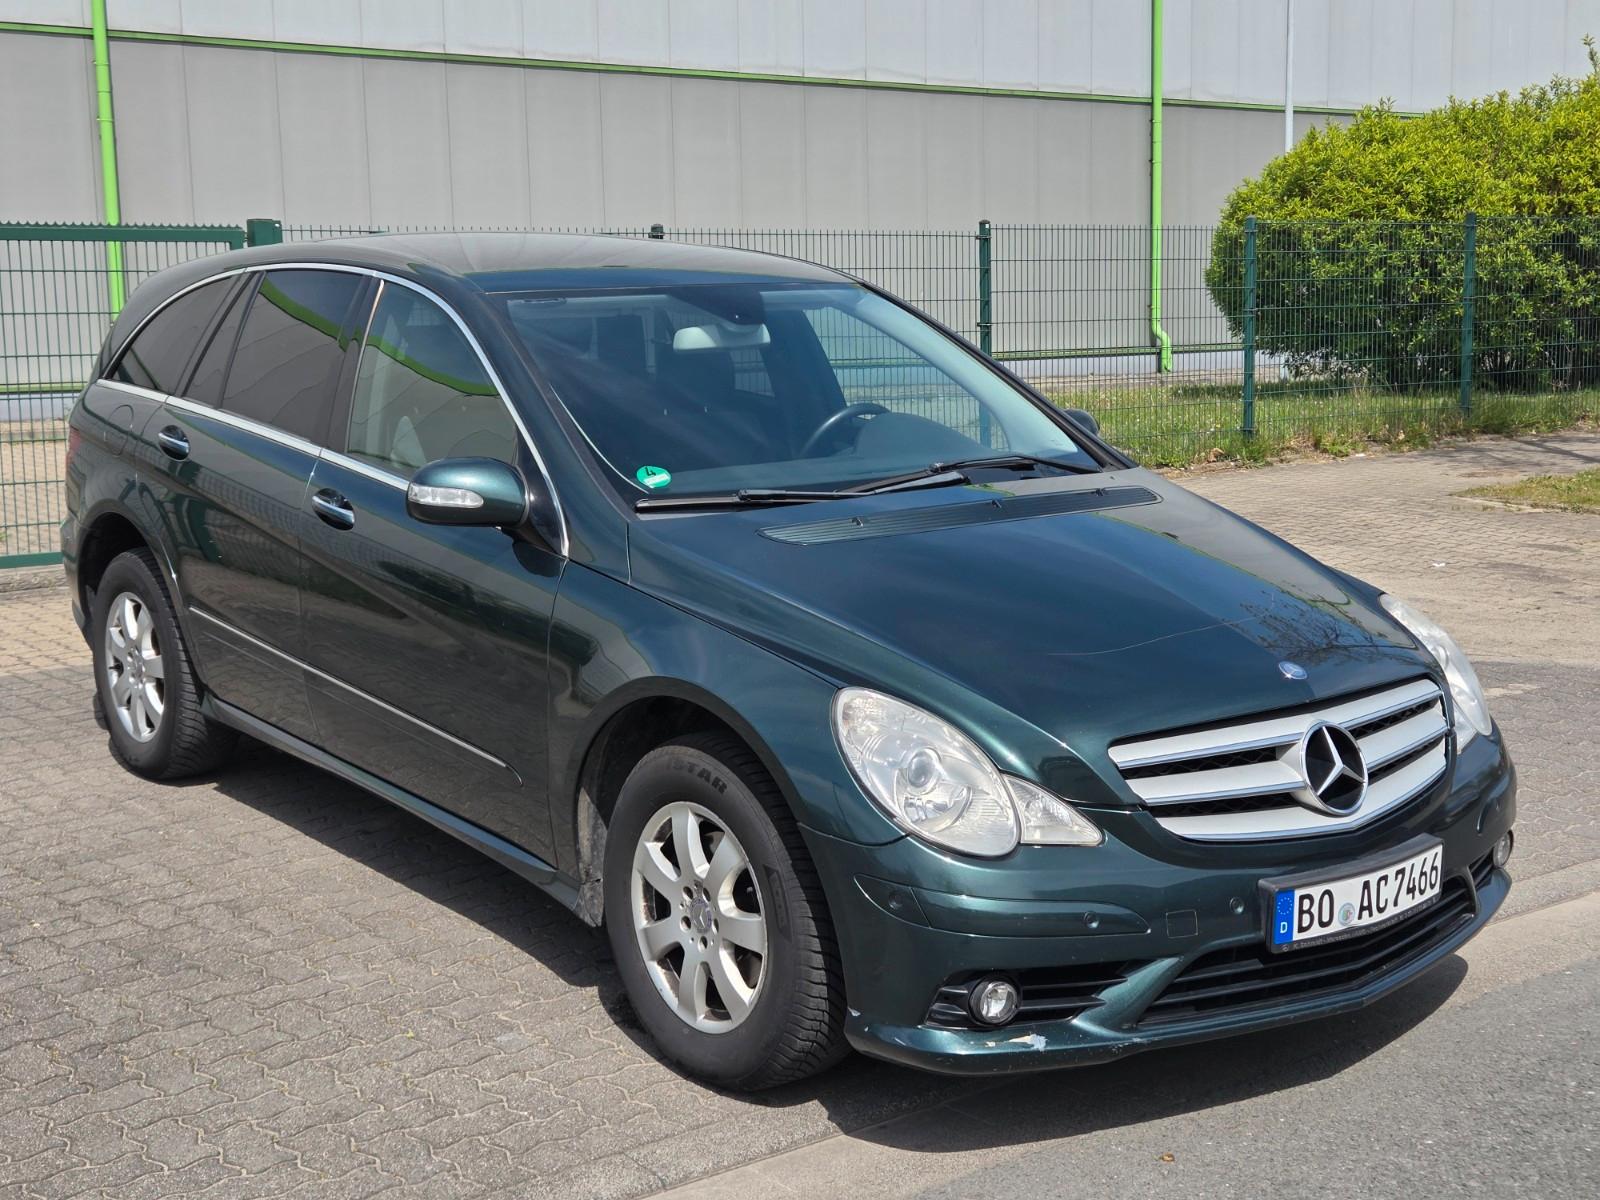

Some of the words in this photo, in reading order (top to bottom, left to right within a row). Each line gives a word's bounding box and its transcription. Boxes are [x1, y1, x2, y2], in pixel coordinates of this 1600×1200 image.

[645, 466, 657, 477] 4
[1298, 889, 1335, 934] BO
[1279, 921, 1288, 934] D
